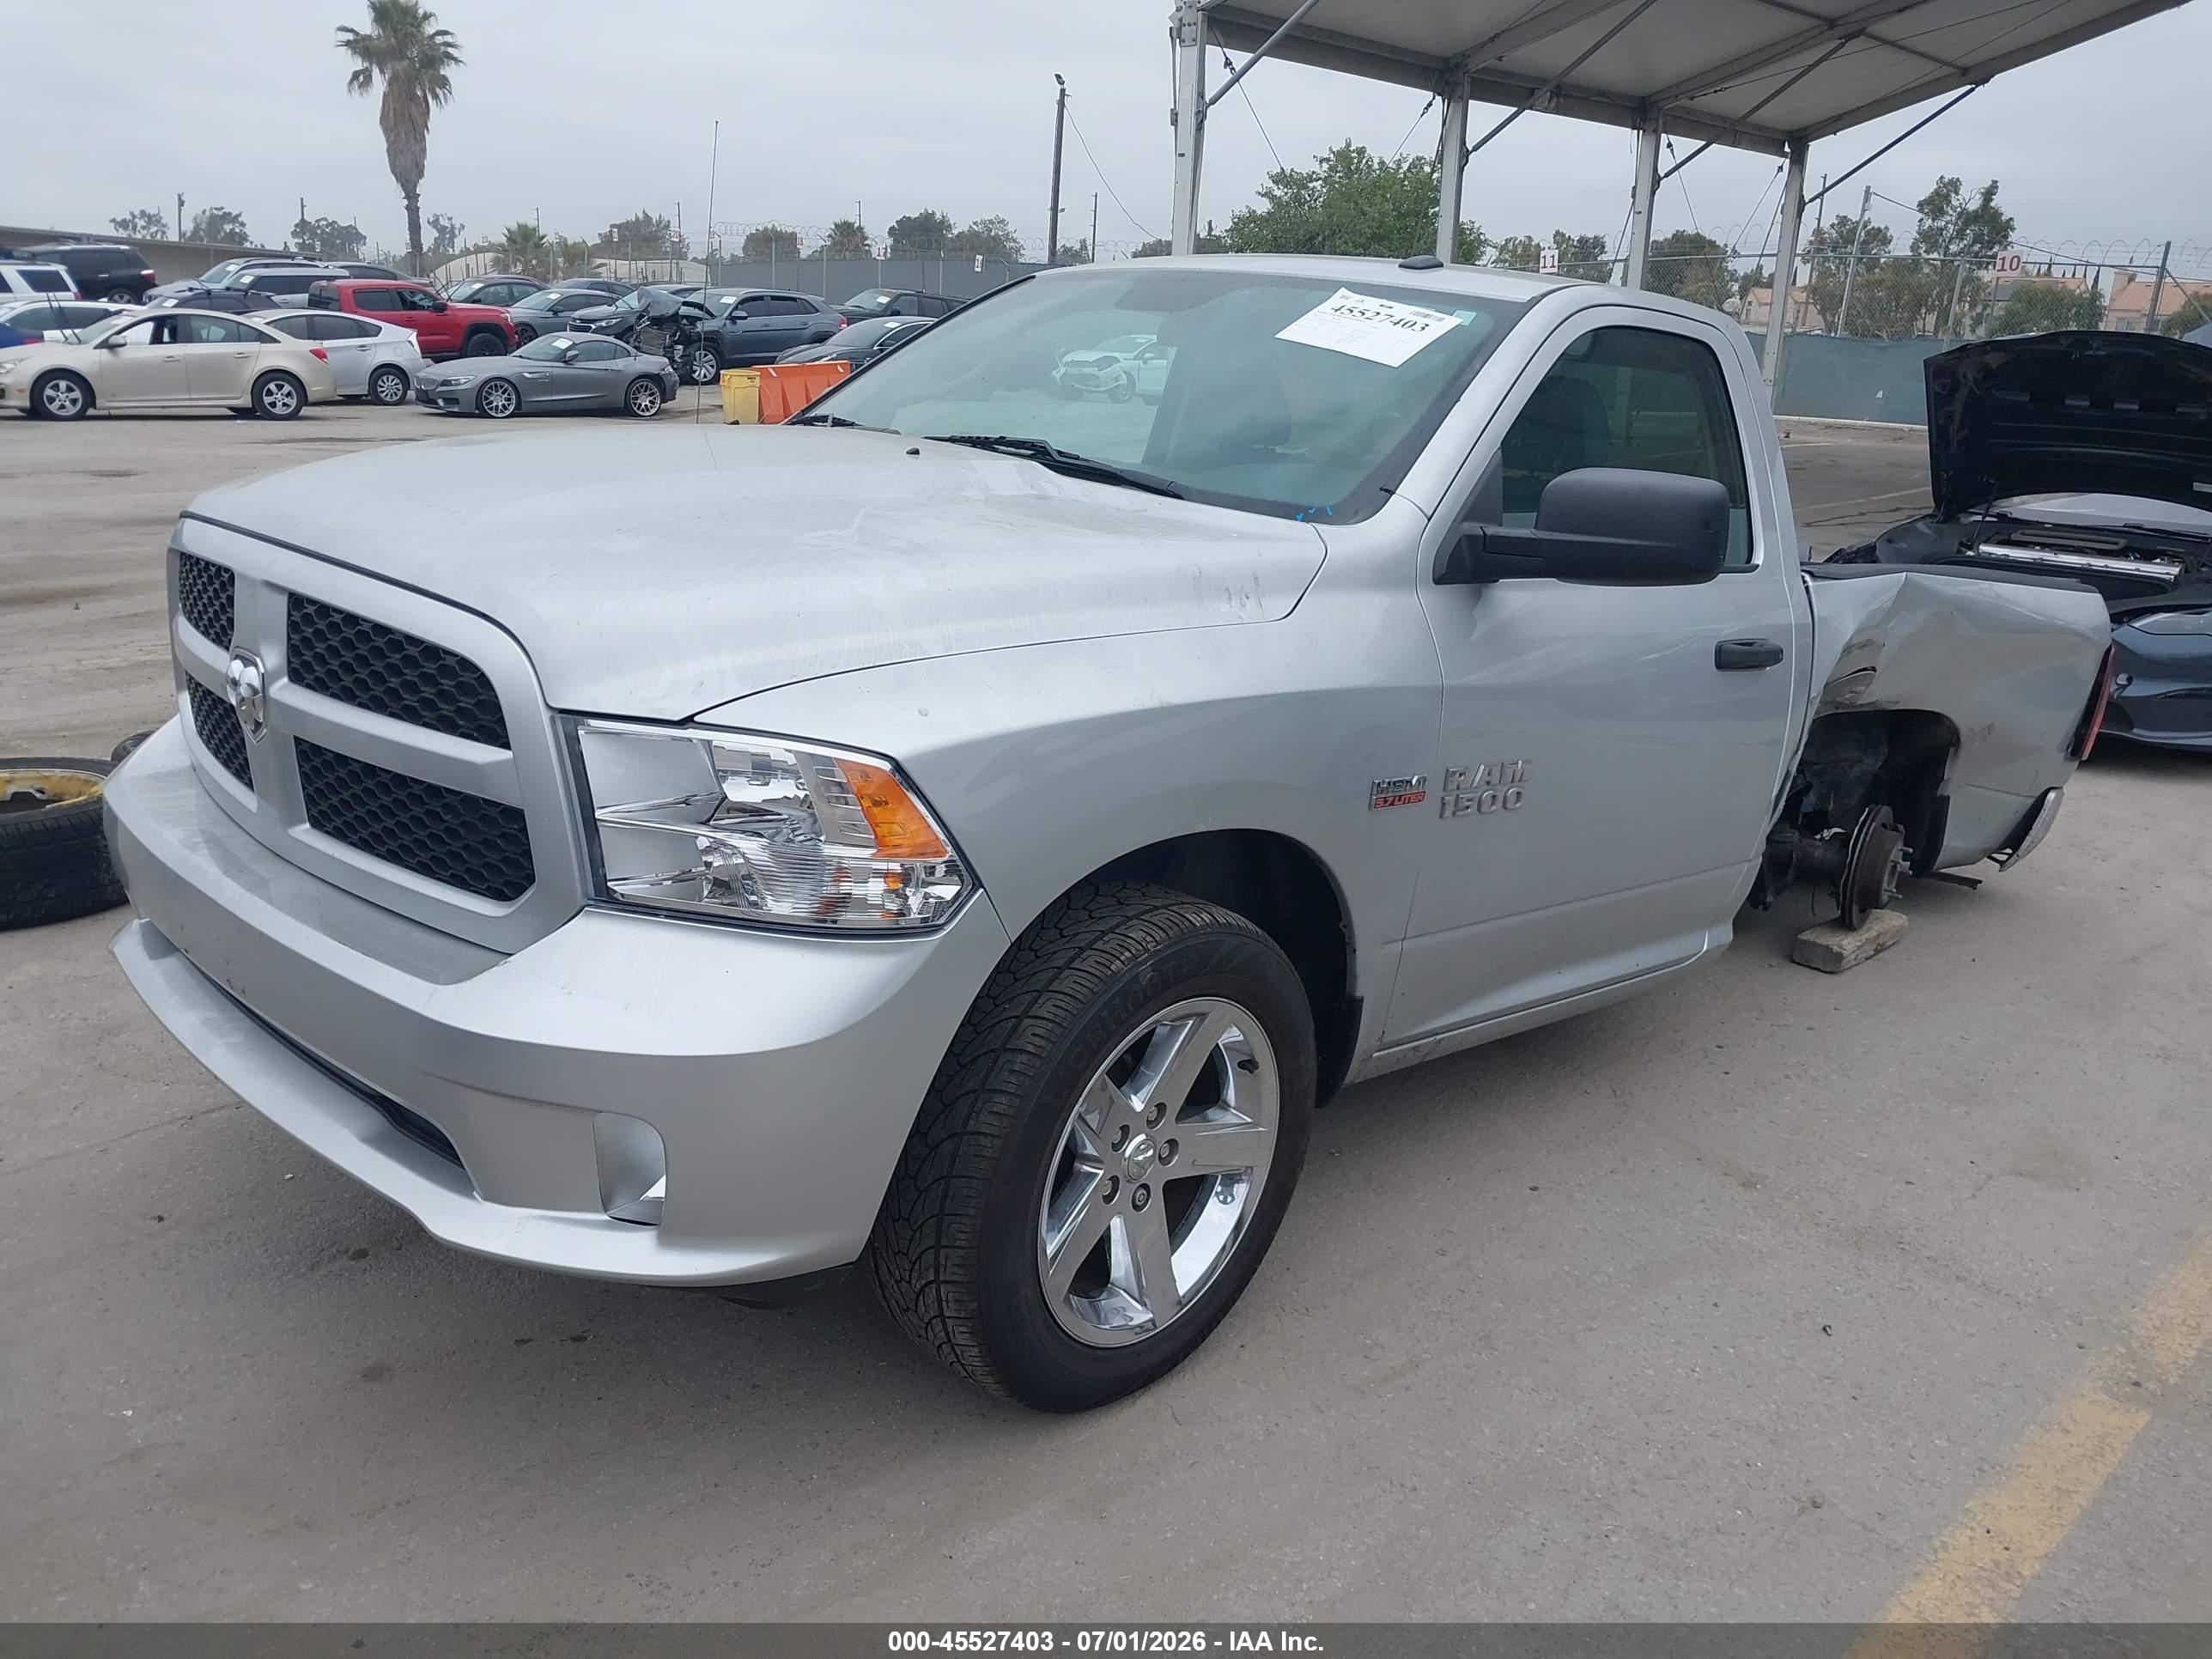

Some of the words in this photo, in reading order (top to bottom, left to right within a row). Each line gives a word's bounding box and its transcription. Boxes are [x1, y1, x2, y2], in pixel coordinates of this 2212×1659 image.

[876, 246, 888, 258] 17
[1540, 254, 1557, 269] 11
[1996, 254, 2021, 272] 10
[1331, 305, 1430, 332] 45527403
[1372, 775, 1426, 795] HEMI
[1443, 760, 1531, 791] RAM
[1439, 787, 1525, 818] 1500
